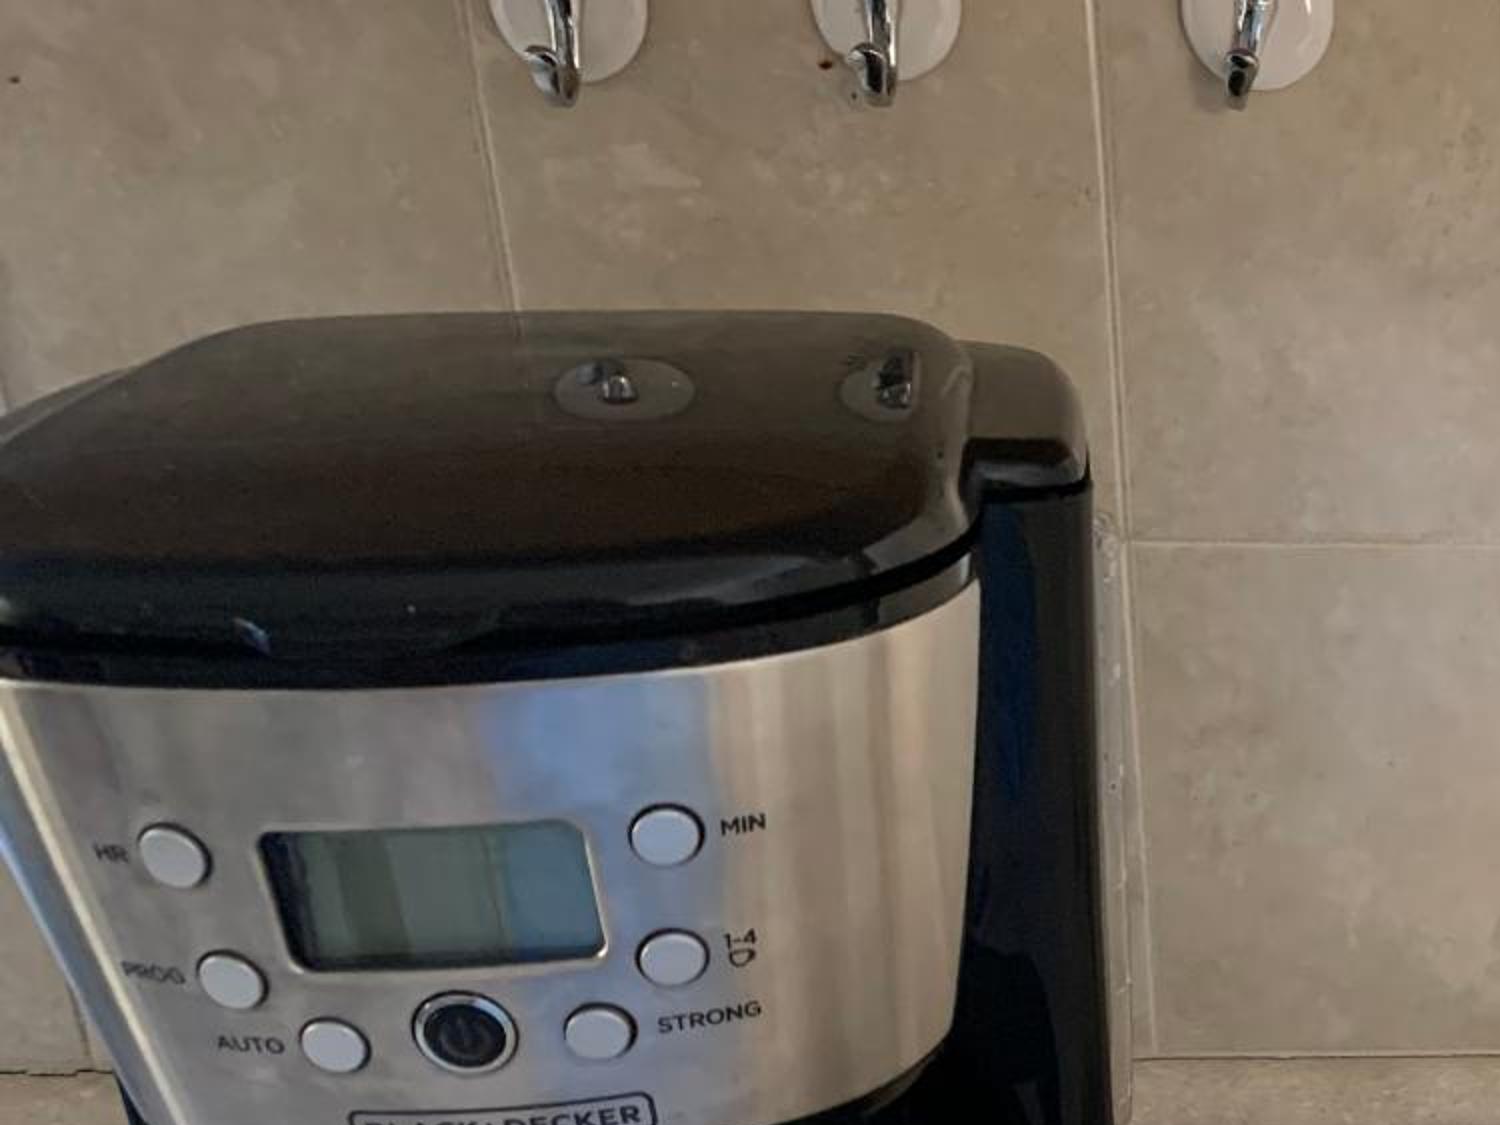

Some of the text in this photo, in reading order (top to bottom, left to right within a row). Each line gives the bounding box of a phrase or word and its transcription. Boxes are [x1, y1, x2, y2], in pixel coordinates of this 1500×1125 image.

[720, 812, 766, 836] MIN
[723, 928, 757, 950] 1-4
[657, 1000, 762, 1035] STRONG
[216, 1034, 286, 1055] AUTO
